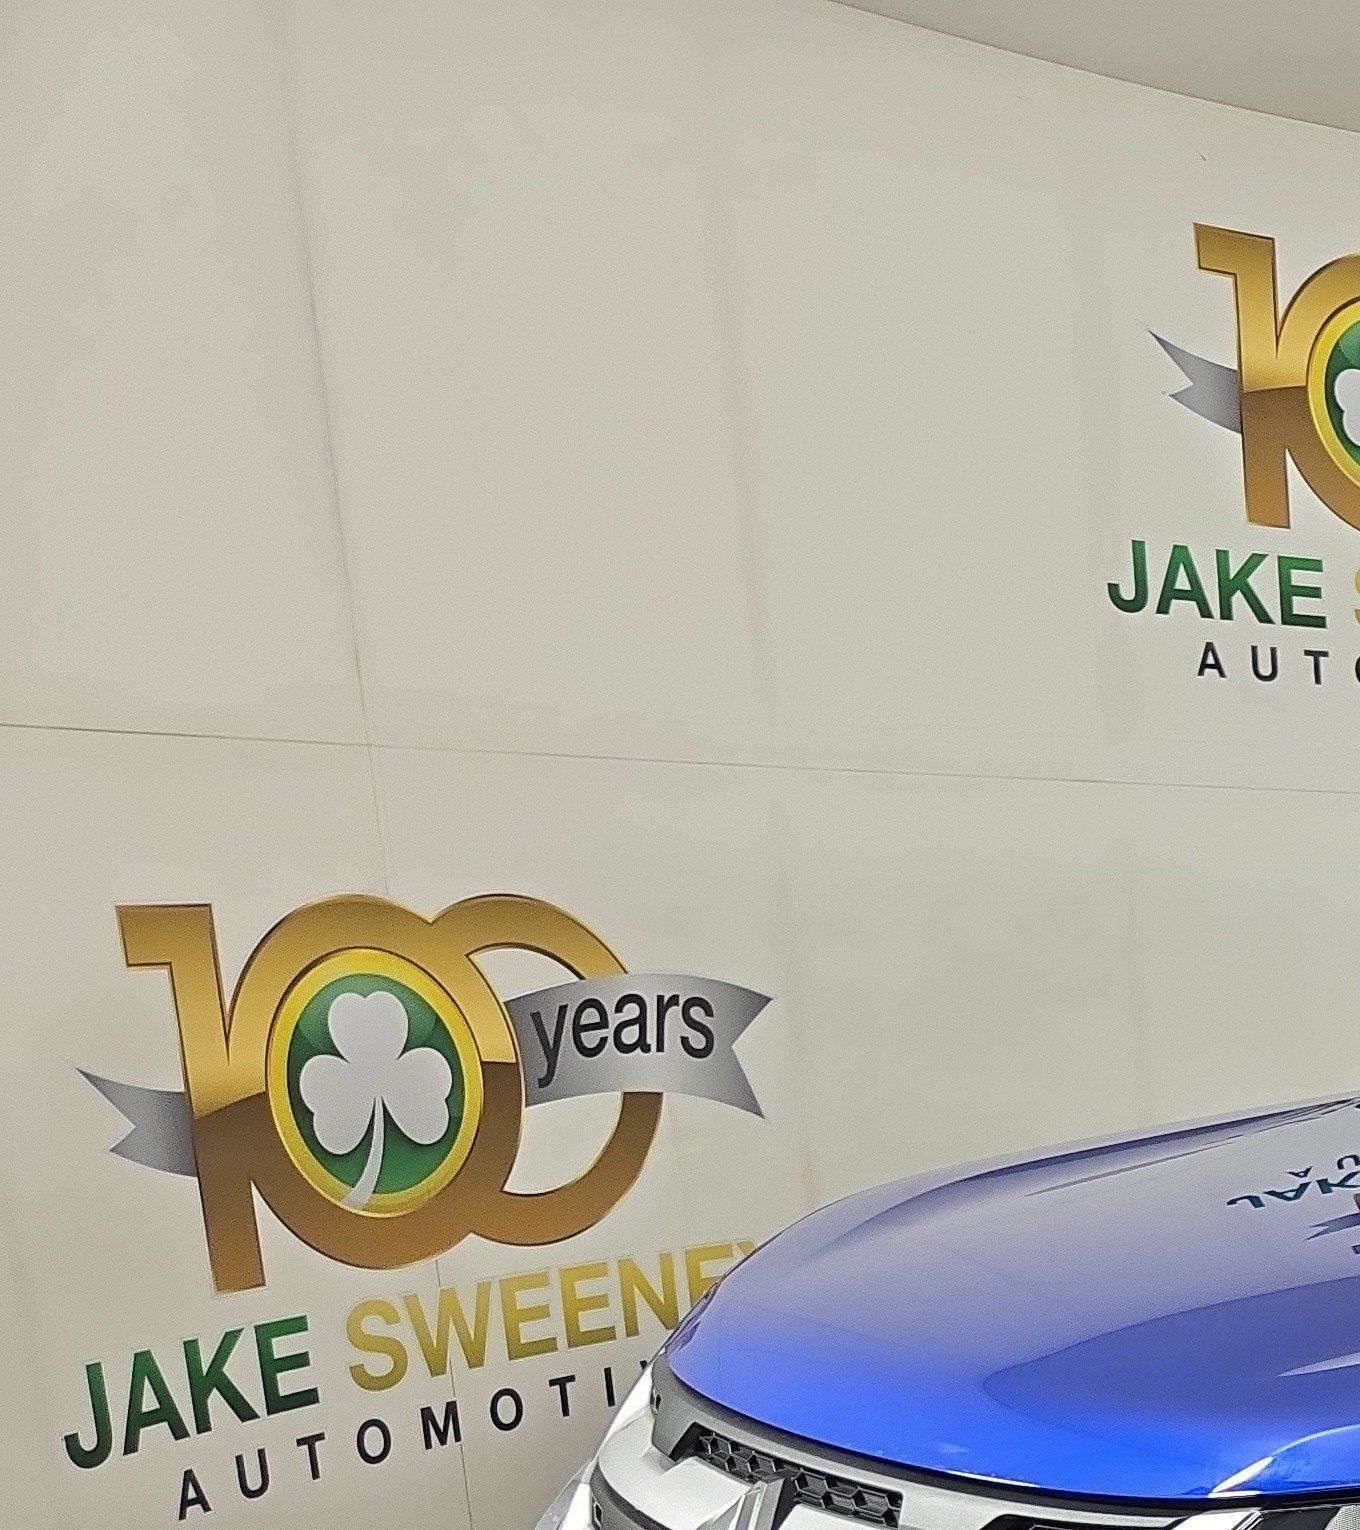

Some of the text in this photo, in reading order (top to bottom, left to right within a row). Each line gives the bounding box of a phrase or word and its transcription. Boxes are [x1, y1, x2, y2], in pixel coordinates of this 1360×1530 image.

[1107, 539, 1328, 629] JAKE
[115, 893, 717, 1293] 100 years
[63, 1238, 756, 1470] JAKE SWEENE
[177, 1359, 648, 1521] AUTOMOTI
